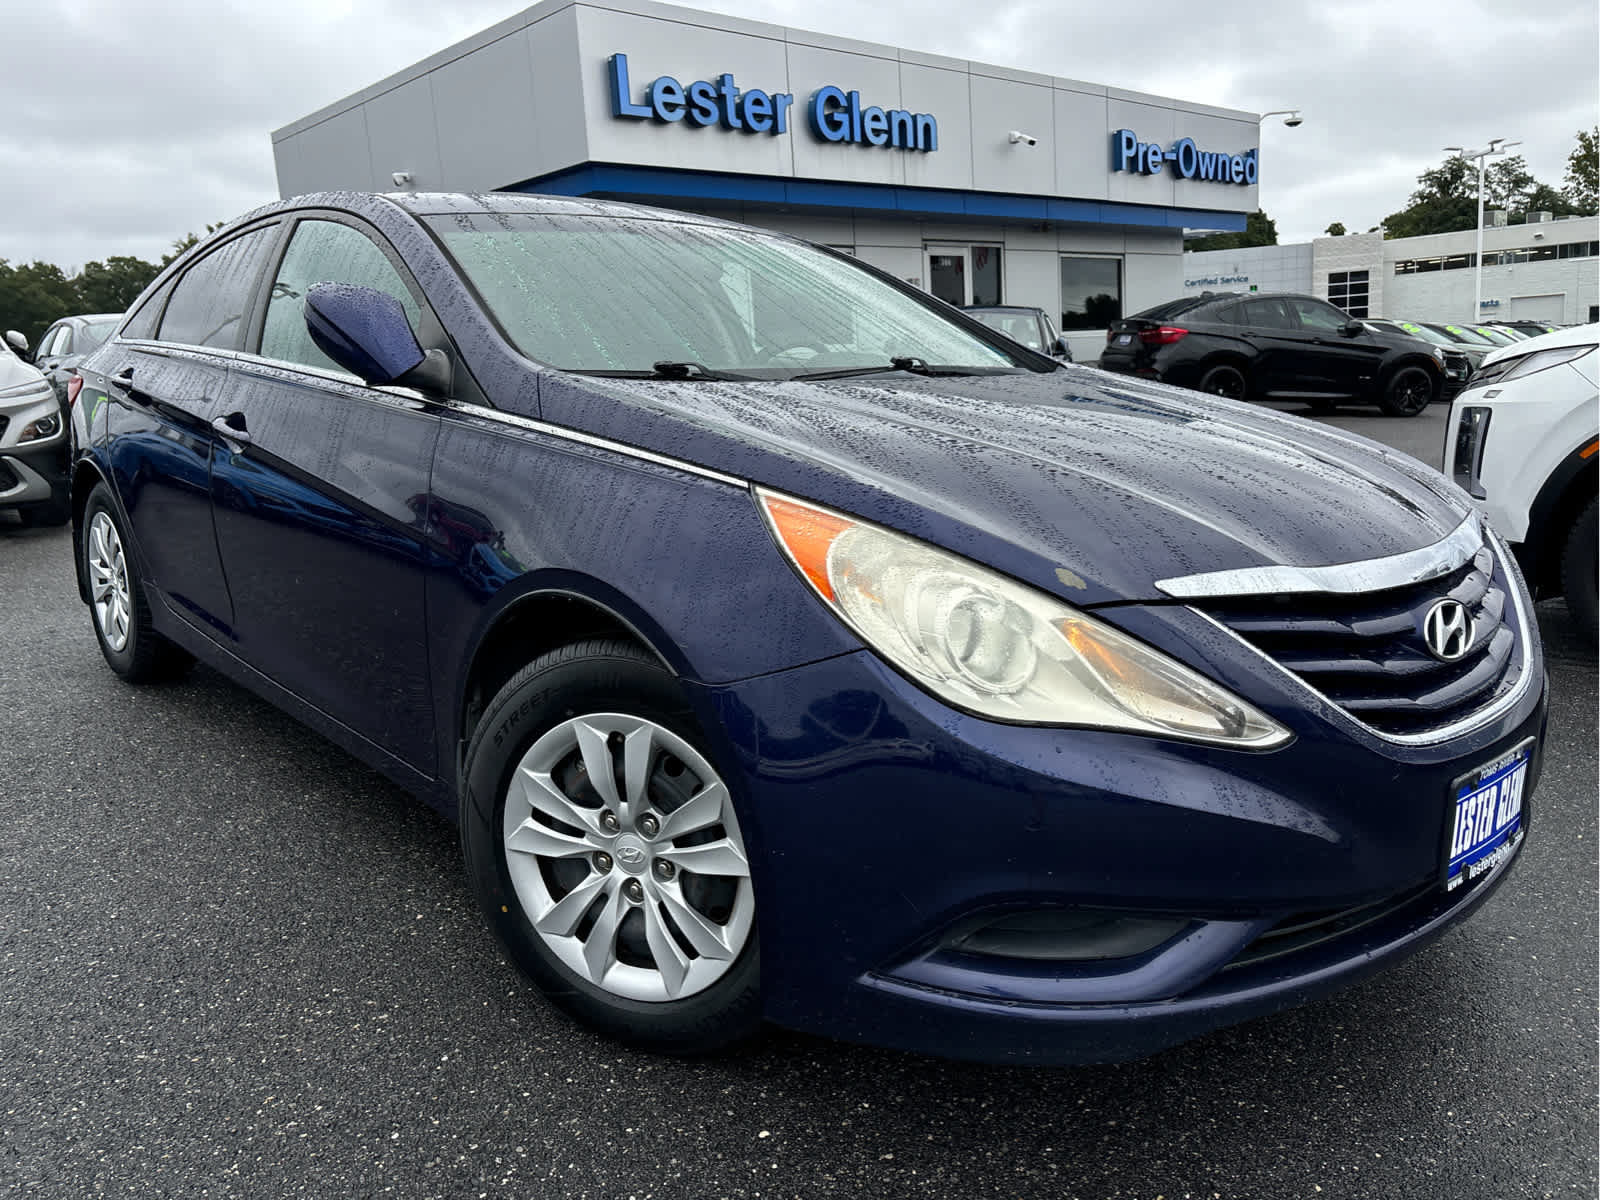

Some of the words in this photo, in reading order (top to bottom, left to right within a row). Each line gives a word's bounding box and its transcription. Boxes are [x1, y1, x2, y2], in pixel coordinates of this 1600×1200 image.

[607, 53, 793, 135] Lester
[808, 85, 938, 152] Glenn
[1112, 129, 1259, 186] Pre-Owned
[1184, 277, 1218, 287] Certified
[1220, 276, 1249, 284] Service
[1450, 784, 1498, 860] LESTER
